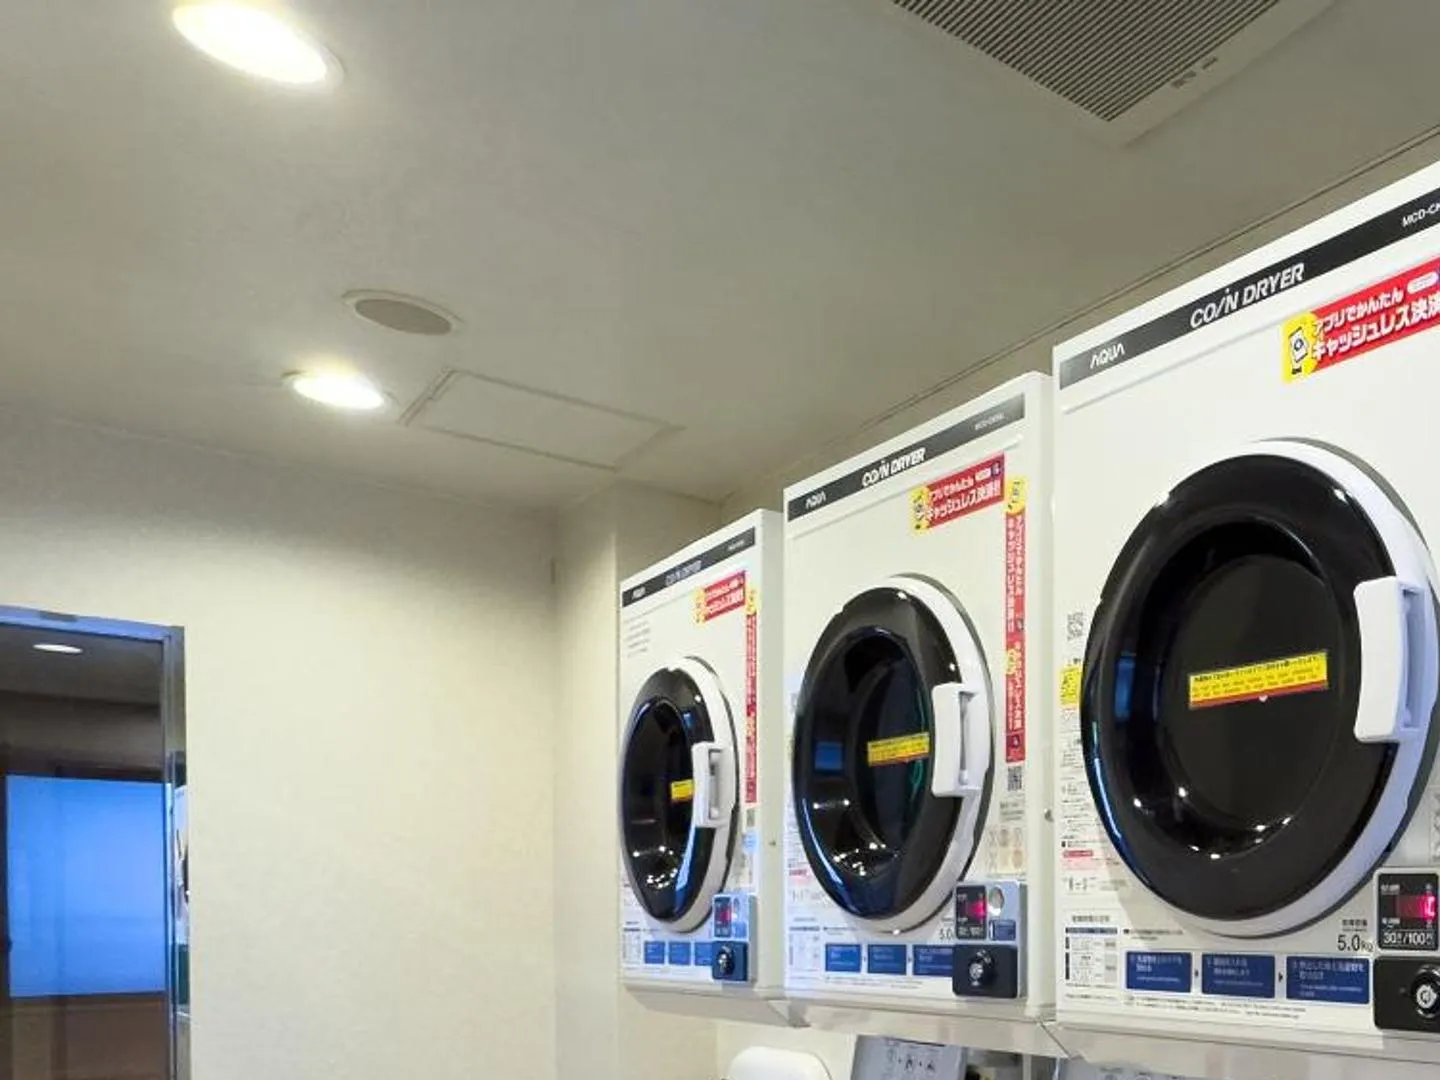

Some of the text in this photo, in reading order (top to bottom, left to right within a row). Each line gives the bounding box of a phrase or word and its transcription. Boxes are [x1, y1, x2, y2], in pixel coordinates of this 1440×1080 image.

[1244, 262, 1305, 304] DRYER
[1314, 287, 1404, 335] アプリでかんたん
[1089, 342, 1126, 368] AQUA
